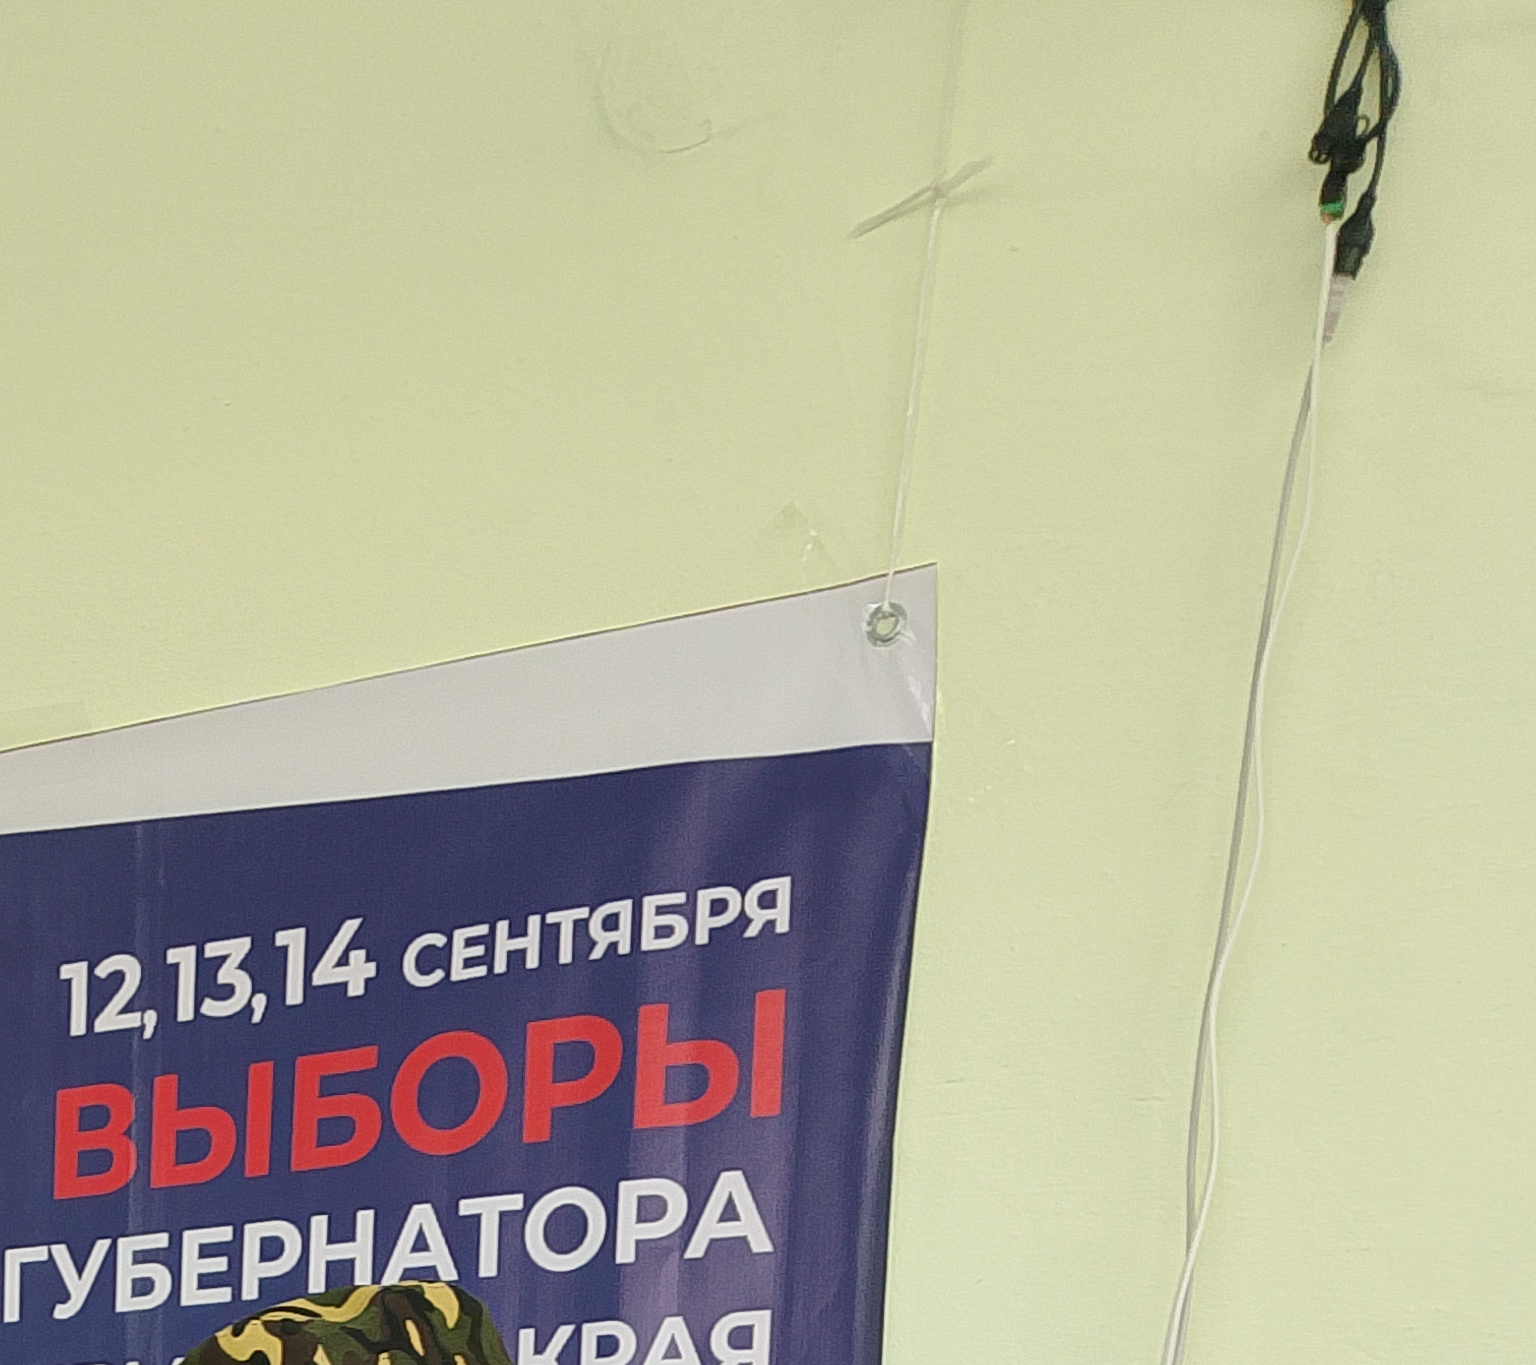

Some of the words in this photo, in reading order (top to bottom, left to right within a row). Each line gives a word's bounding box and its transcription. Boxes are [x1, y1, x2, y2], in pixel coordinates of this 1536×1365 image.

[402, 876, 793, 988] СЕНТЯБРЯ
[54, 990, 786, 1199] ВЫБОРЫ
[3, 1170, 774, 1324] ГУБЕРНАТОРА
